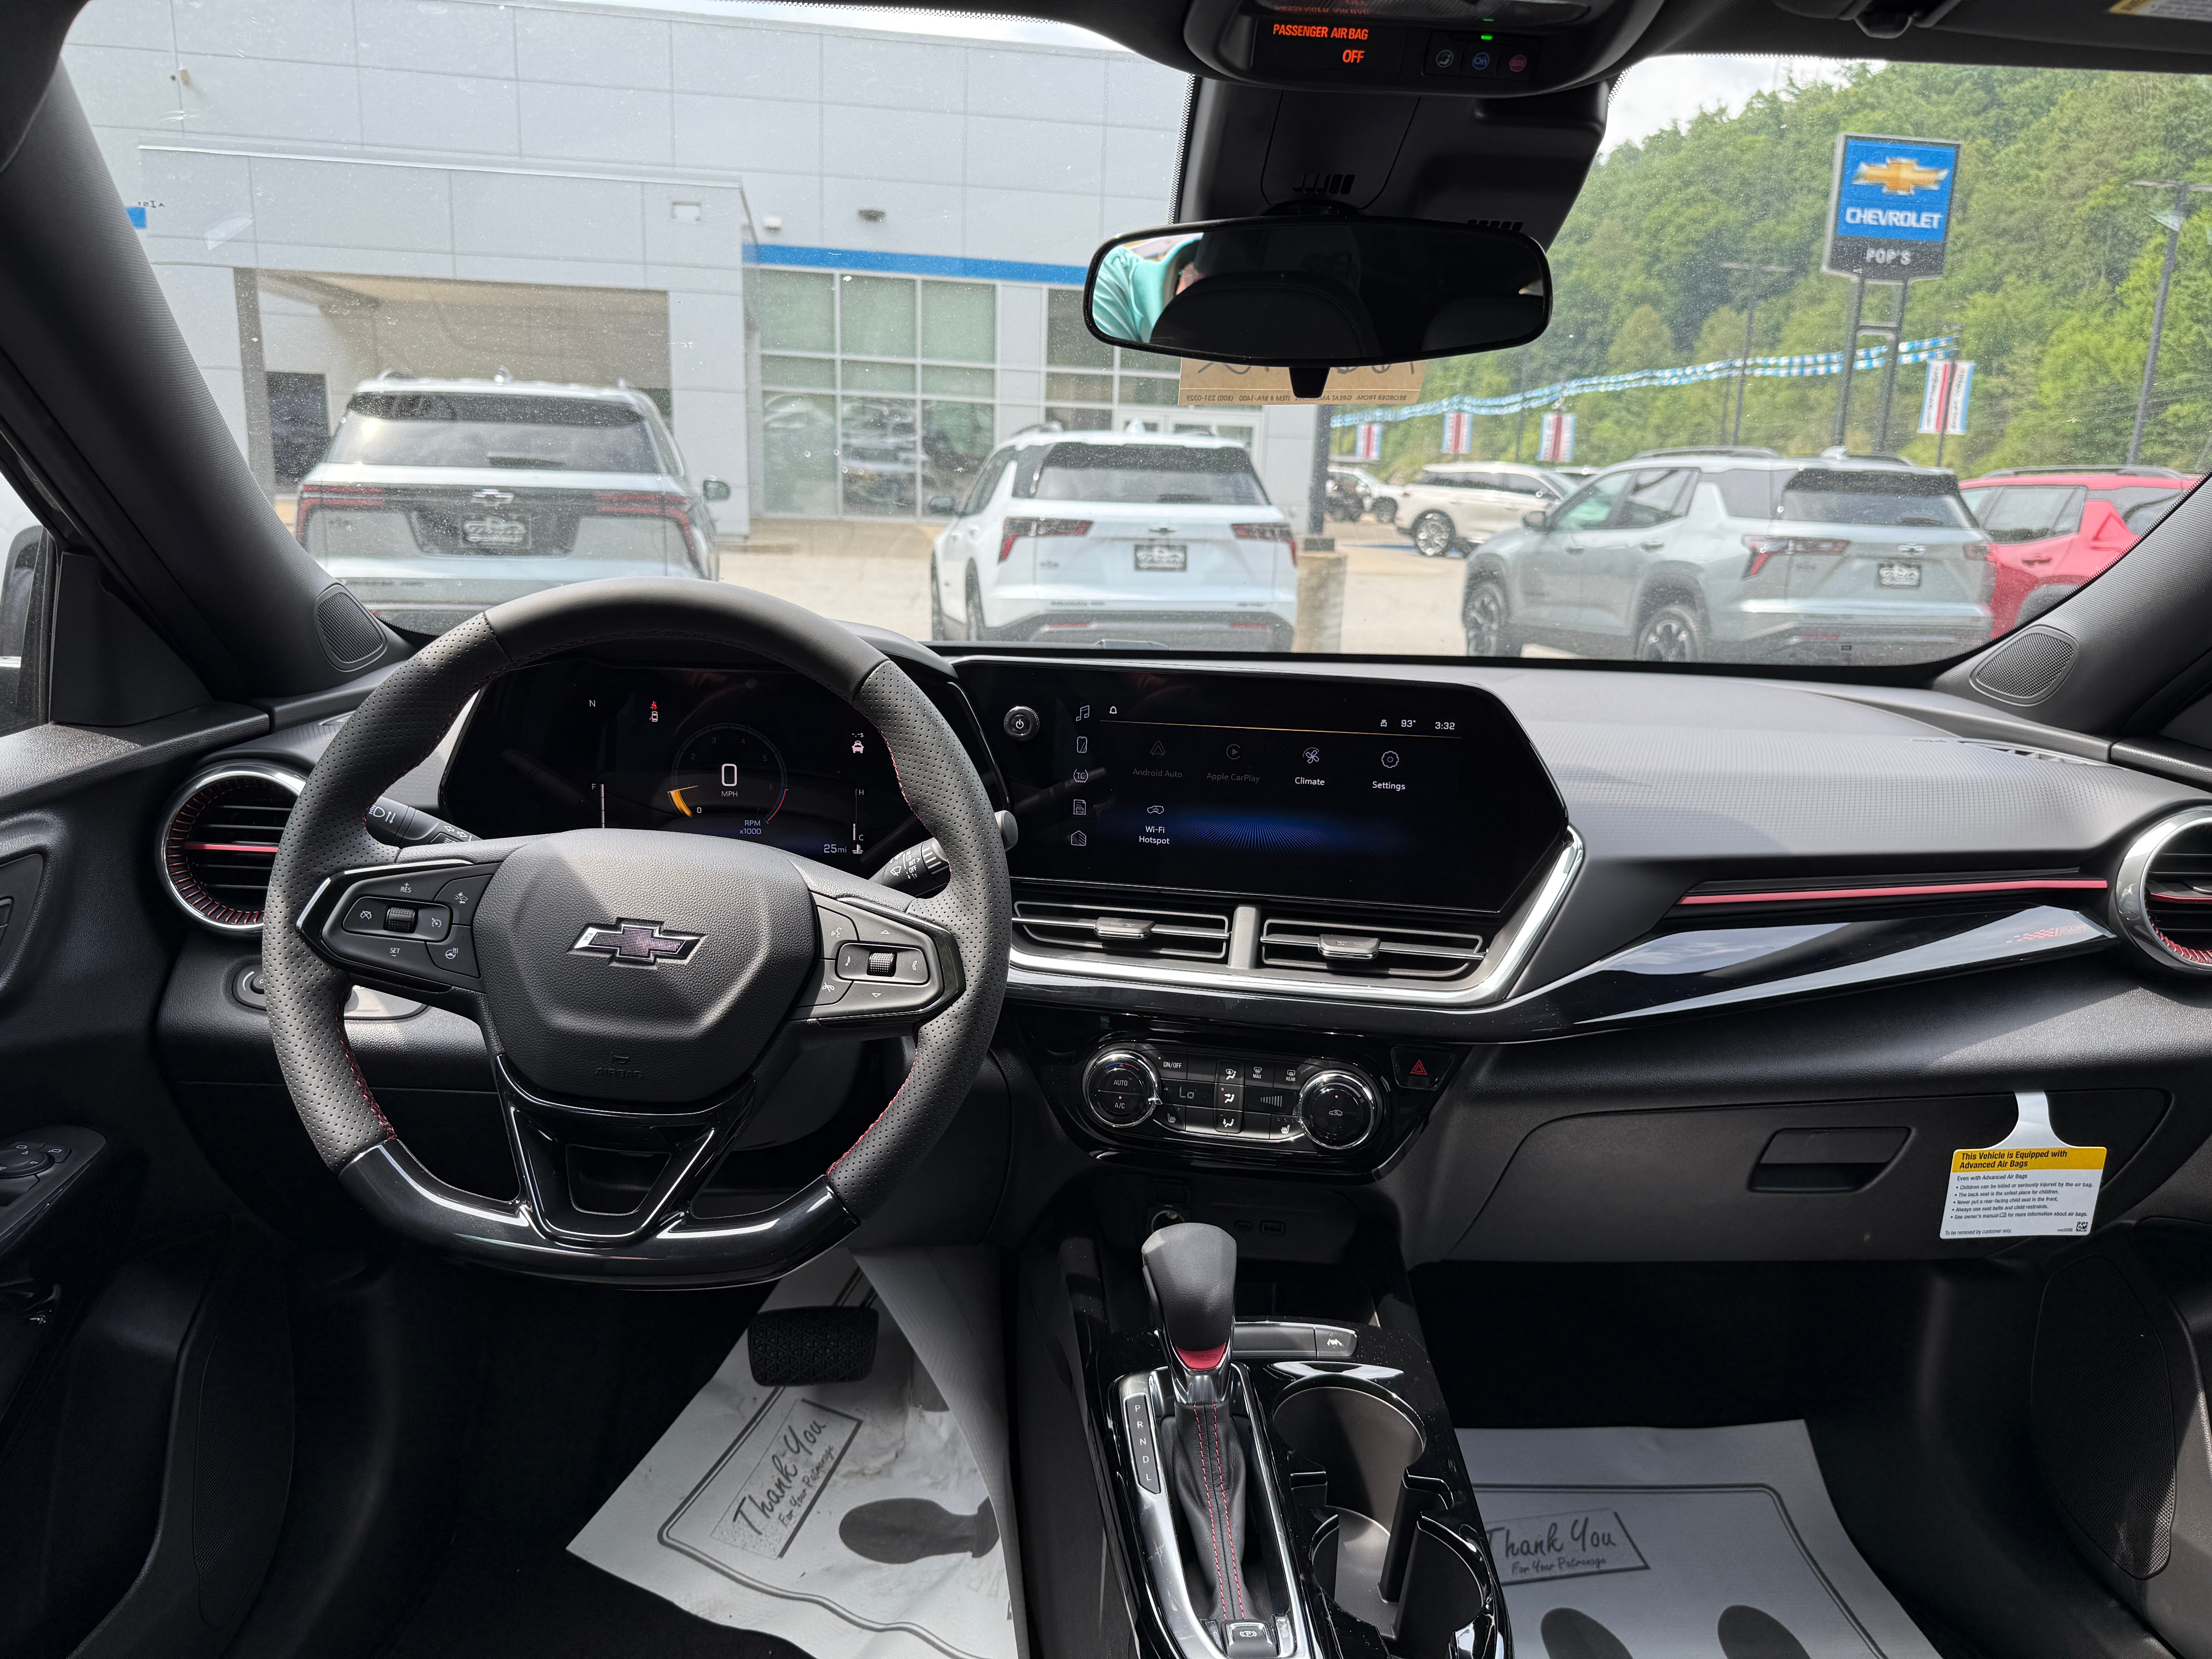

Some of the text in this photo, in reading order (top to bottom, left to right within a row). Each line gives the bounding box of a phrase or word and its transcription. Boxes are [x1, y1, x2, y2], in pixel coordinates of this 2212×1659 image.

[1273, 24, 1369, 40] PASSENGER AIR BAG
[1343, 50, 1365, 63] OFF
[1845, 207, 1943, 229] CHEVROLET
[1866, 247, 1911, 265] POP'S
[1435, 721, 1455, 730] 3:32
[721, 763, 737, 787] 0
[1132, 768, 1163, 777] Android
[1206, 773, 1260, 783] Apple CarPlay
[1295, 777, 1325, 786] Climate
[1372, 781, 1406, 791] Settings
[1139, 836, 1170, 845] Hotspot
[908, 865, 917, 873] OFF
[596, 1067, 644, 1079] AIRBAG
[1979, 1151, 2005, 1159] Vehicle
[2015, 1150, 2049, 1159] Equipped
[1960, 1161, 1996, 1169] Advanced
[2010, 1160, 2028, 1168] Bags
[1137, 1420, 1144, 1428] R
[1140, 1437, 1147, 1446] N
[1143, 1455, 1150, 1464] D
[733, 1420, 827, 1535] Thank You
[1146, 1473, 1151, 1481] L
[778, 1445, 834, 1527] For Your Patronage
[1486, 1517, 1616, 1558] Thank You
[1512, 1556, 1606, 1575] For Your Patronage
